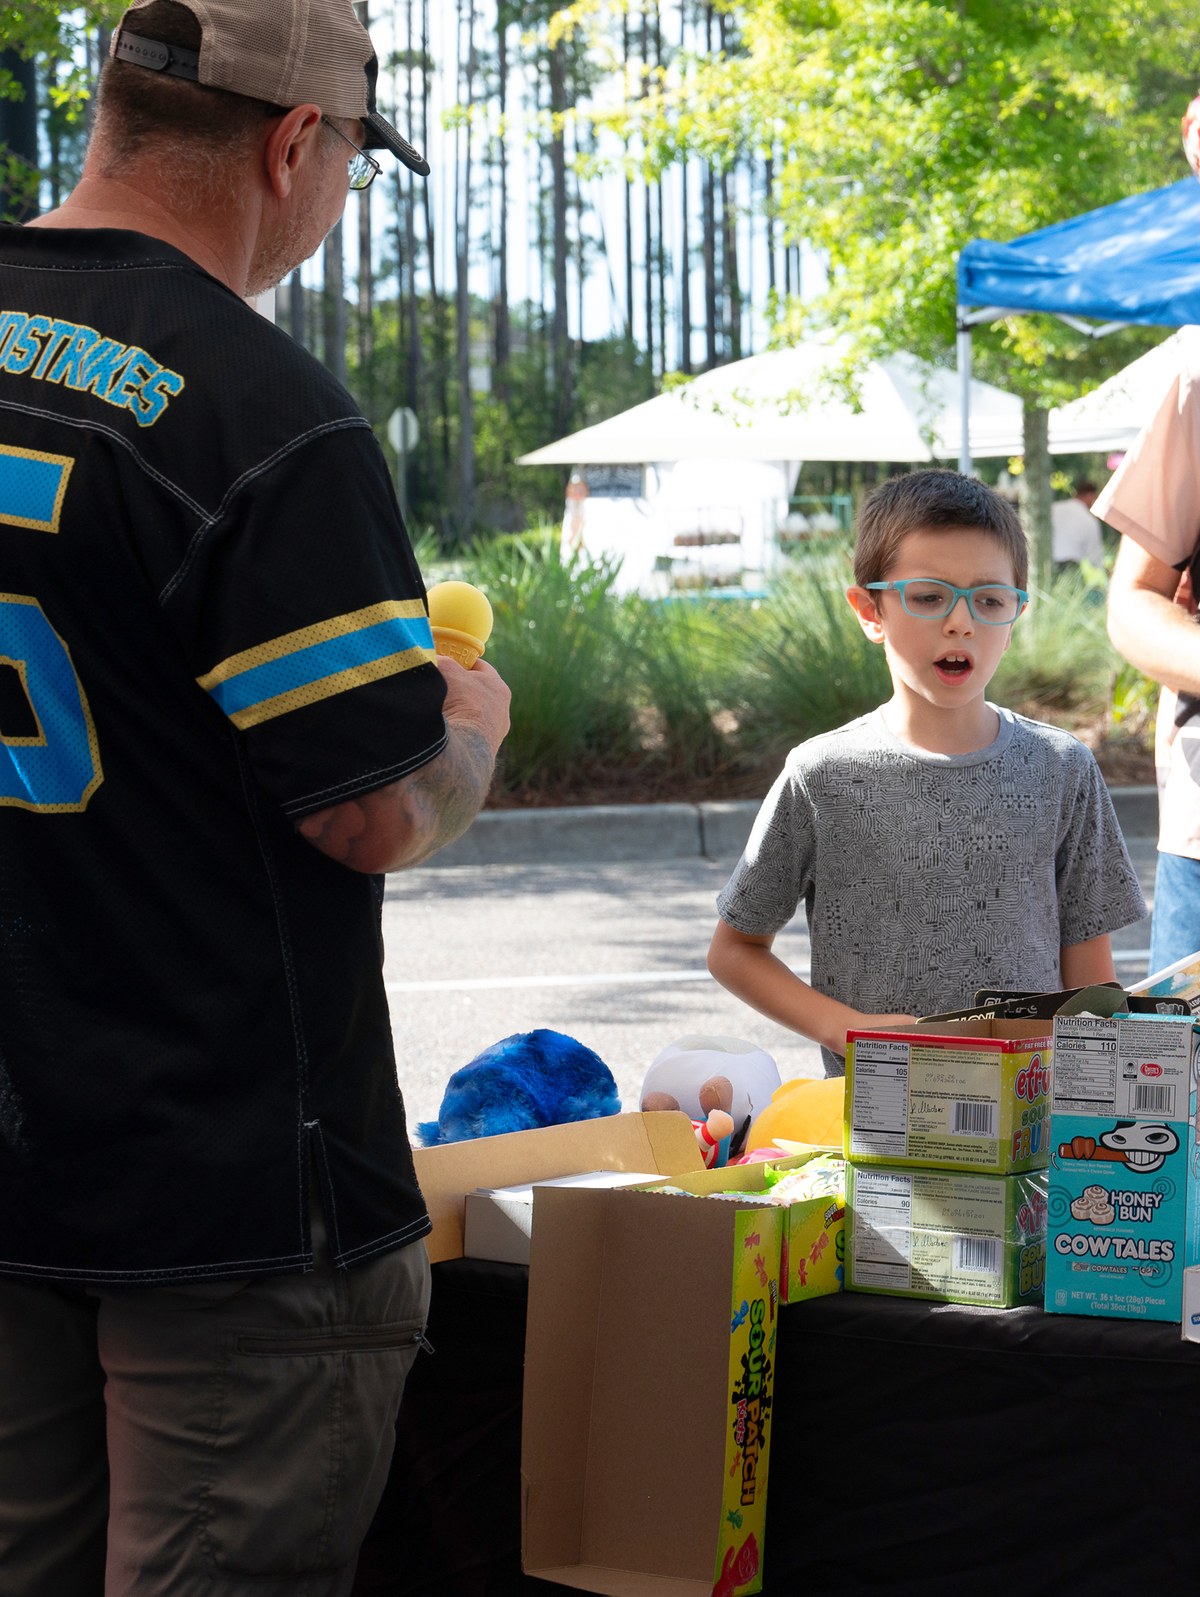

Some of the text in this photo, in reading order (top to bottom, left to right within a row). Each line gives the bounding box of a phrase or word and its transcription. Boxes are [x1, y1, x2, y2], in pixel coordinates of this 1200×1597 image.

[1057, 1018, 1118, 1029] Nutrition Facts
[856, 1041, 909, 1051] Nutrition Facts
[1056, 1041, 1116, 1051] Calories 110
[896, 1068, 908, 1076] 105
[857, 1172, 911, 1184] Nutrition Facts
[1111, 1191, 1162, 1208] HONEY
[1119, 1207, 1152, 1222] BUN
[1126, 1295, 1143, 1304] (28g)
[1145, 1297, 1166, 1305] Pieces
[1091, 1301, 1110, 1310] (Total
[1110, 1303, 1126, 1311] 36oz
[749, 1299, 767, 1399] SOUR
[735, 1398, 748, 1445] Kids
[740, 1400, 763, 1506] PATCH
